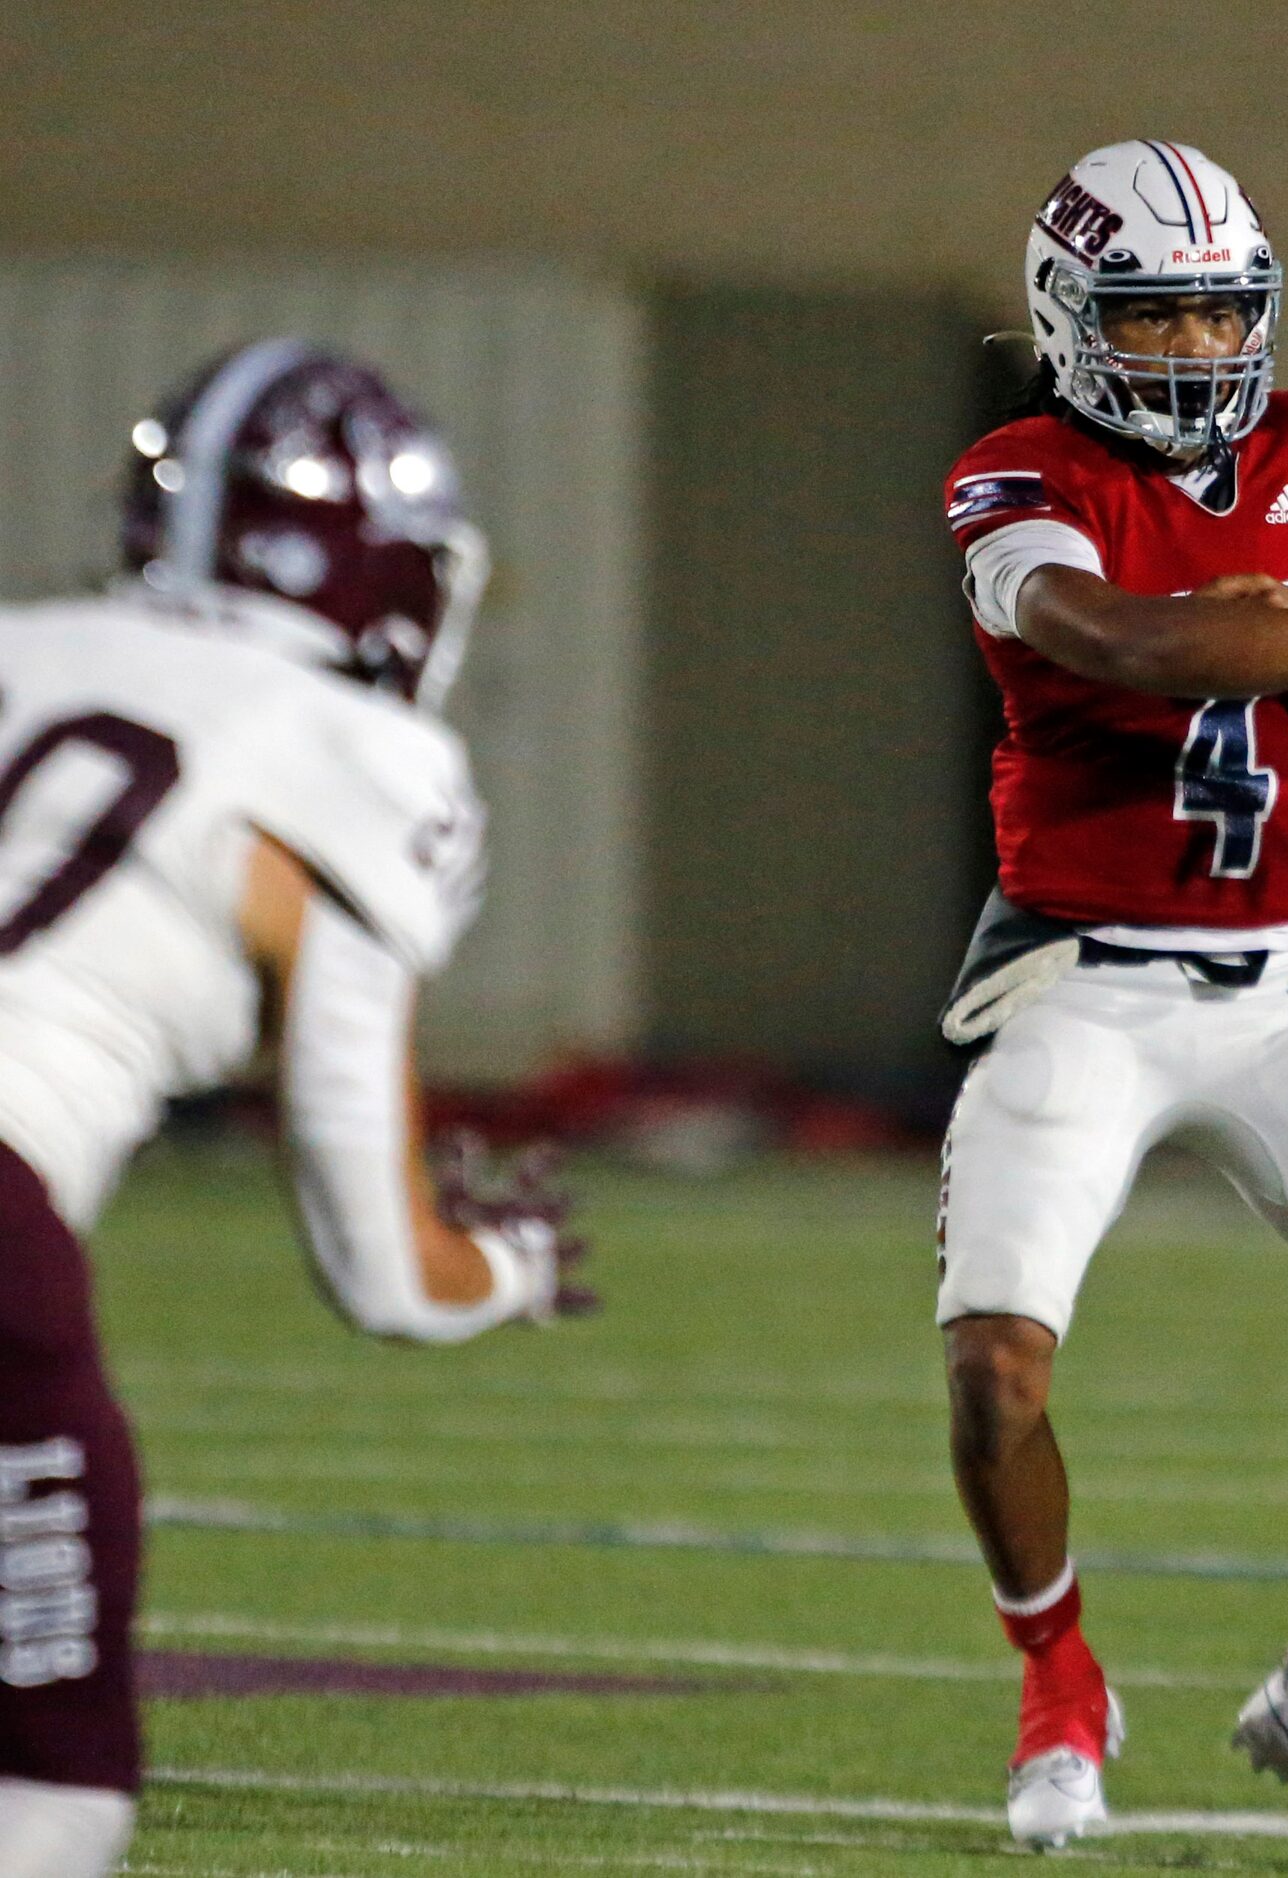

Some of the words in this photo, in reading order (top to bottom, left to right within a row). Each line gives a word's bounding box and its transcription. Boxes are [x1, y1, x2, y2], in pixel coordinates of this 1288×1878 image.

[1037, 173, 1124, 256] IGHTS
[1173, 696, 1279, 880] 4
[0, 1436, 98, 1687] LIONS
